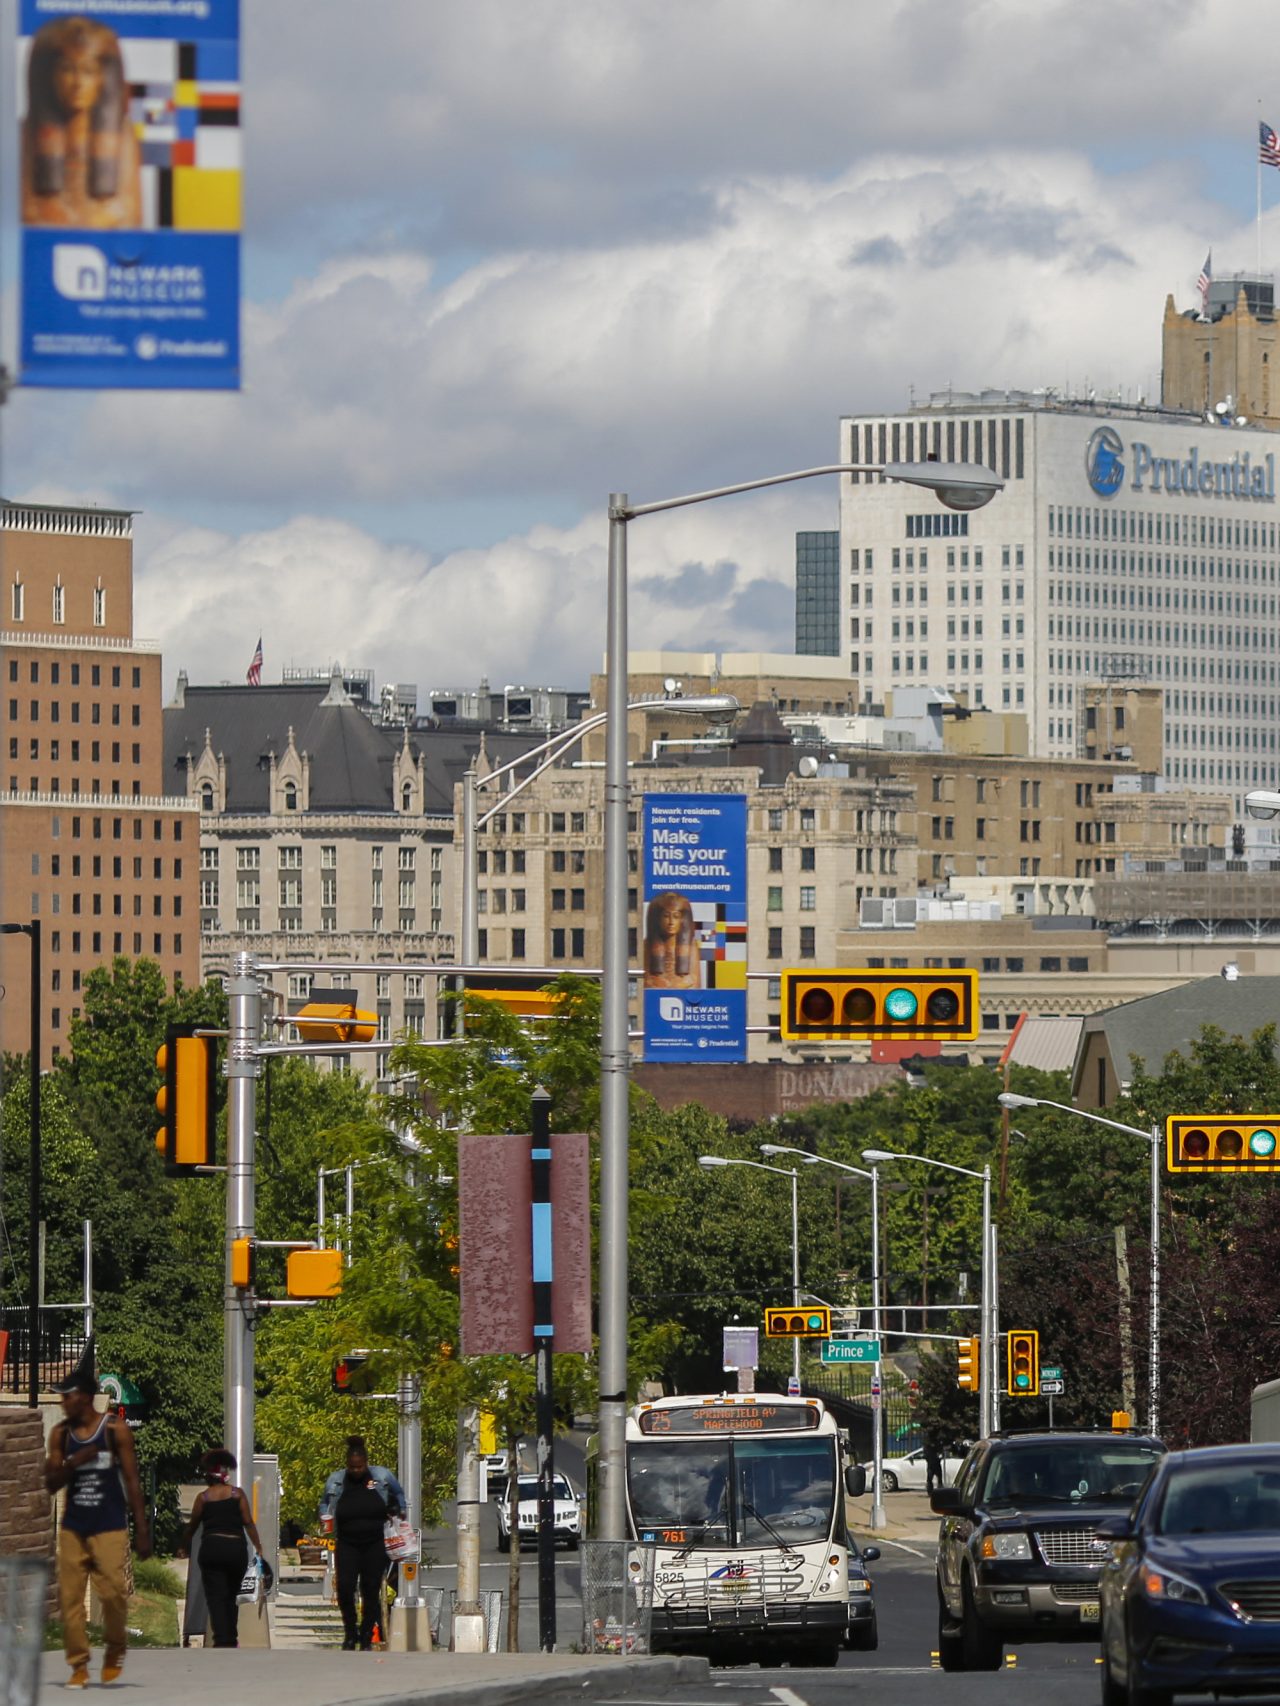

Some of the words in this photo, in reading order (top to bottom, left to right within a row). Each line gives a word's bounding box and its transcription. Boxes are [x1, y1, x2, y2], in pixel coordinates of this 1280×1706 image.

[1131, 442, 1276, 503] Prudential
[652, 816, 666, 824] join
[652, 829, 699, 844] Make
[652, 846, 684, 860] this
[688, 848, 727, 863] your
[652, 861, 731, 876] Museum.
[652, 883, 731, 891] newarkmuseum.org
[828, 1345, 864, 1357] Prince
[692, 1408, 759, 1419] SPRINGFIELD
[762, 1407, 776, 1418] AV
[651, 1411, 672, 1431] 25
[703, 1419, 764, 1429] MAPLEWOOD
[663, 1530, 686, 1542] 761
[656, 1572, 685, 1583] 5825
